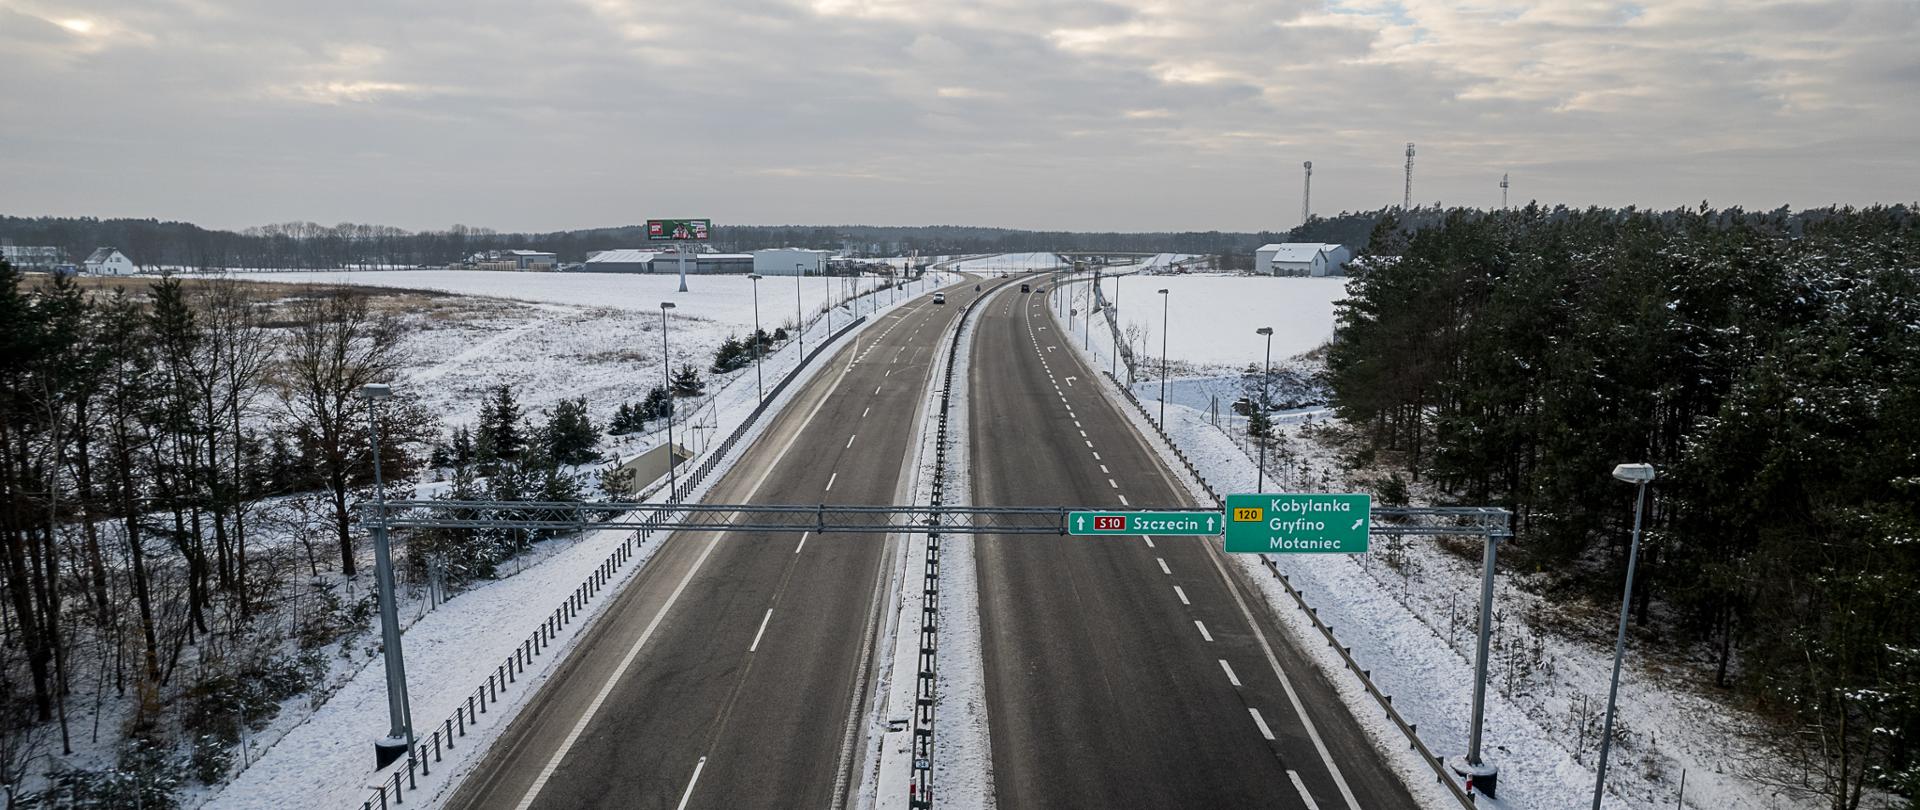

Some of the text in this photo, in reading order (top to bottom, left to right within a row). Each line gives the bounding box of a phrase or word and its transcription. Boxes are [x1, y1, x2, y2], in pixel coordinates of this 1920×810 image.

[1271, 499, 1350, 515] Kobylanka
[1239, 510, 1258, 520] 120
[1133, 517, 1198, 530] Szczecin
[1269, 518, 1325, 534] Gryfino
[1269, 536, 1341, 549] Motaniec
